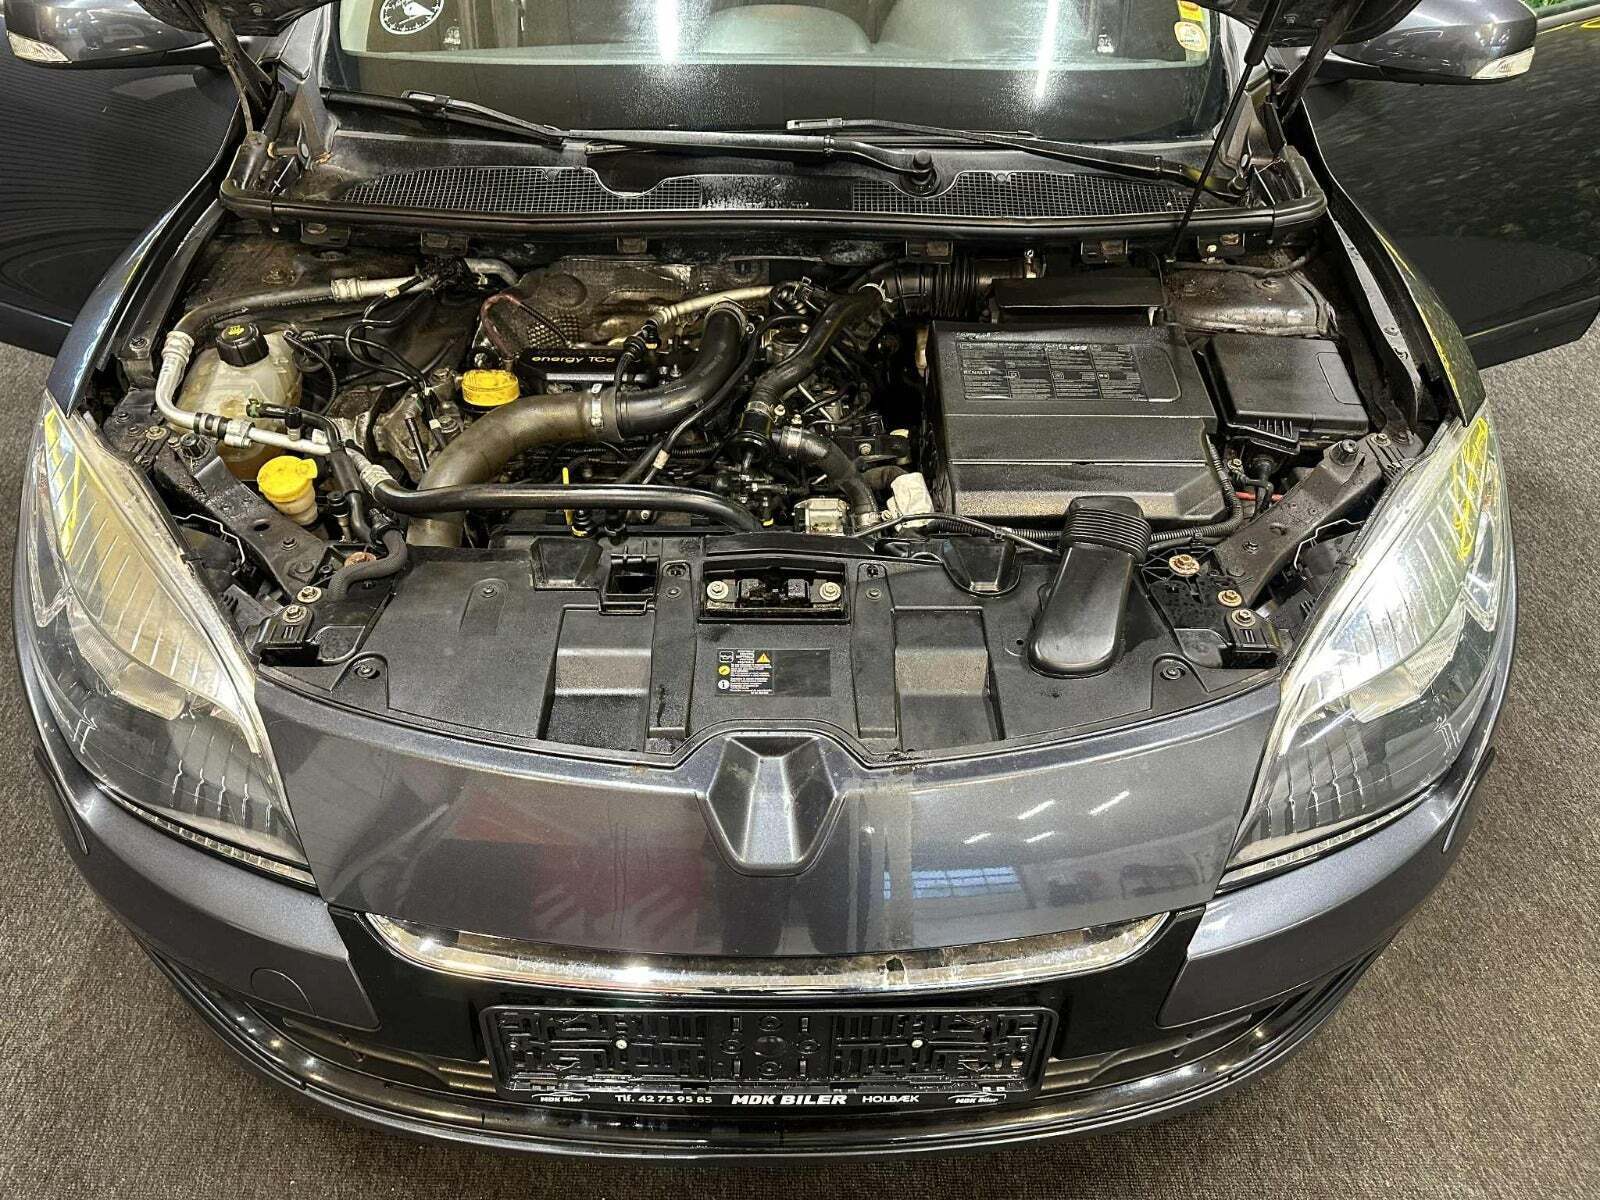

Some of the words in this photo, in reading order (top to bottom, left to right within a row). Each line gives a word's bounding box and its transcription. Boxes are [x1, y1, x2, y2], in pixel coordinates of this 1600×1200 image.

[531, 356, 584, 364] energy
[614, 1094, 635, 1103] Tlf.
[638, 1095, 654, 1103] 42
[657, 1095, 674, 1103] 75
[676, 1095, 693, 1104] 95
[696, 1096, 713, 1104] 85
[731, 1094, 776, 1105] MDK
[780, 1094, 847, 1105] BILER
[862, 1094, 919, 1103] HOLBÆK
